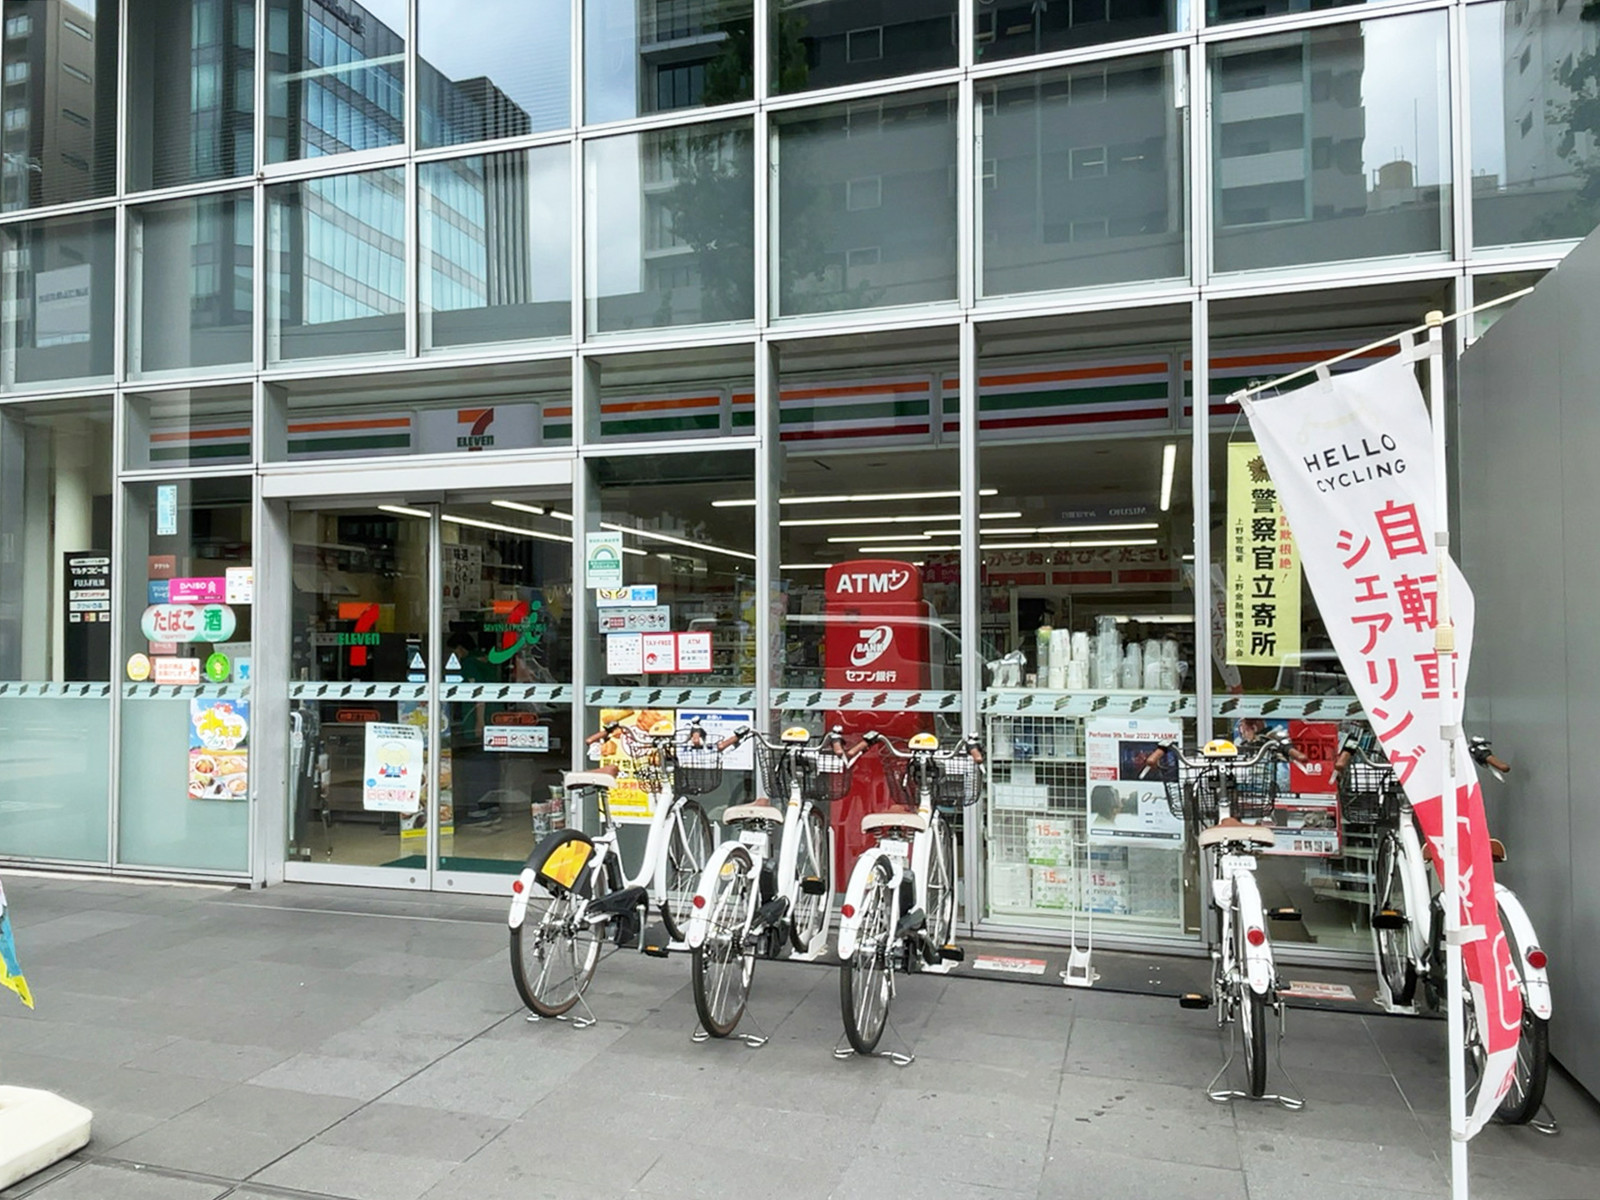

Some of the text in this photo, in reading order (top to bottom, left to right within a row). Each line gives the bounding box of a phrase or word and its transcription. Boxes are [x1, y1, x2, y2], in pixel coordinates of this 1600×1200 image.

[1303, 434, 1396, 473] HELLO
[1317, 459, 1406, 493] CYCLING
[179, 581, 207, 590] DAISO
[1251, 488, 1277, 657] 警察官立寄所
[1374, 499, 1460, 701] 自転車
[153, 609, 195, 632] たばこ
[204, 609, 222, 632] 酒
[1335, 527, 1426, 786] シェアリング
[845, 669, 897, 683] セブン銀行
